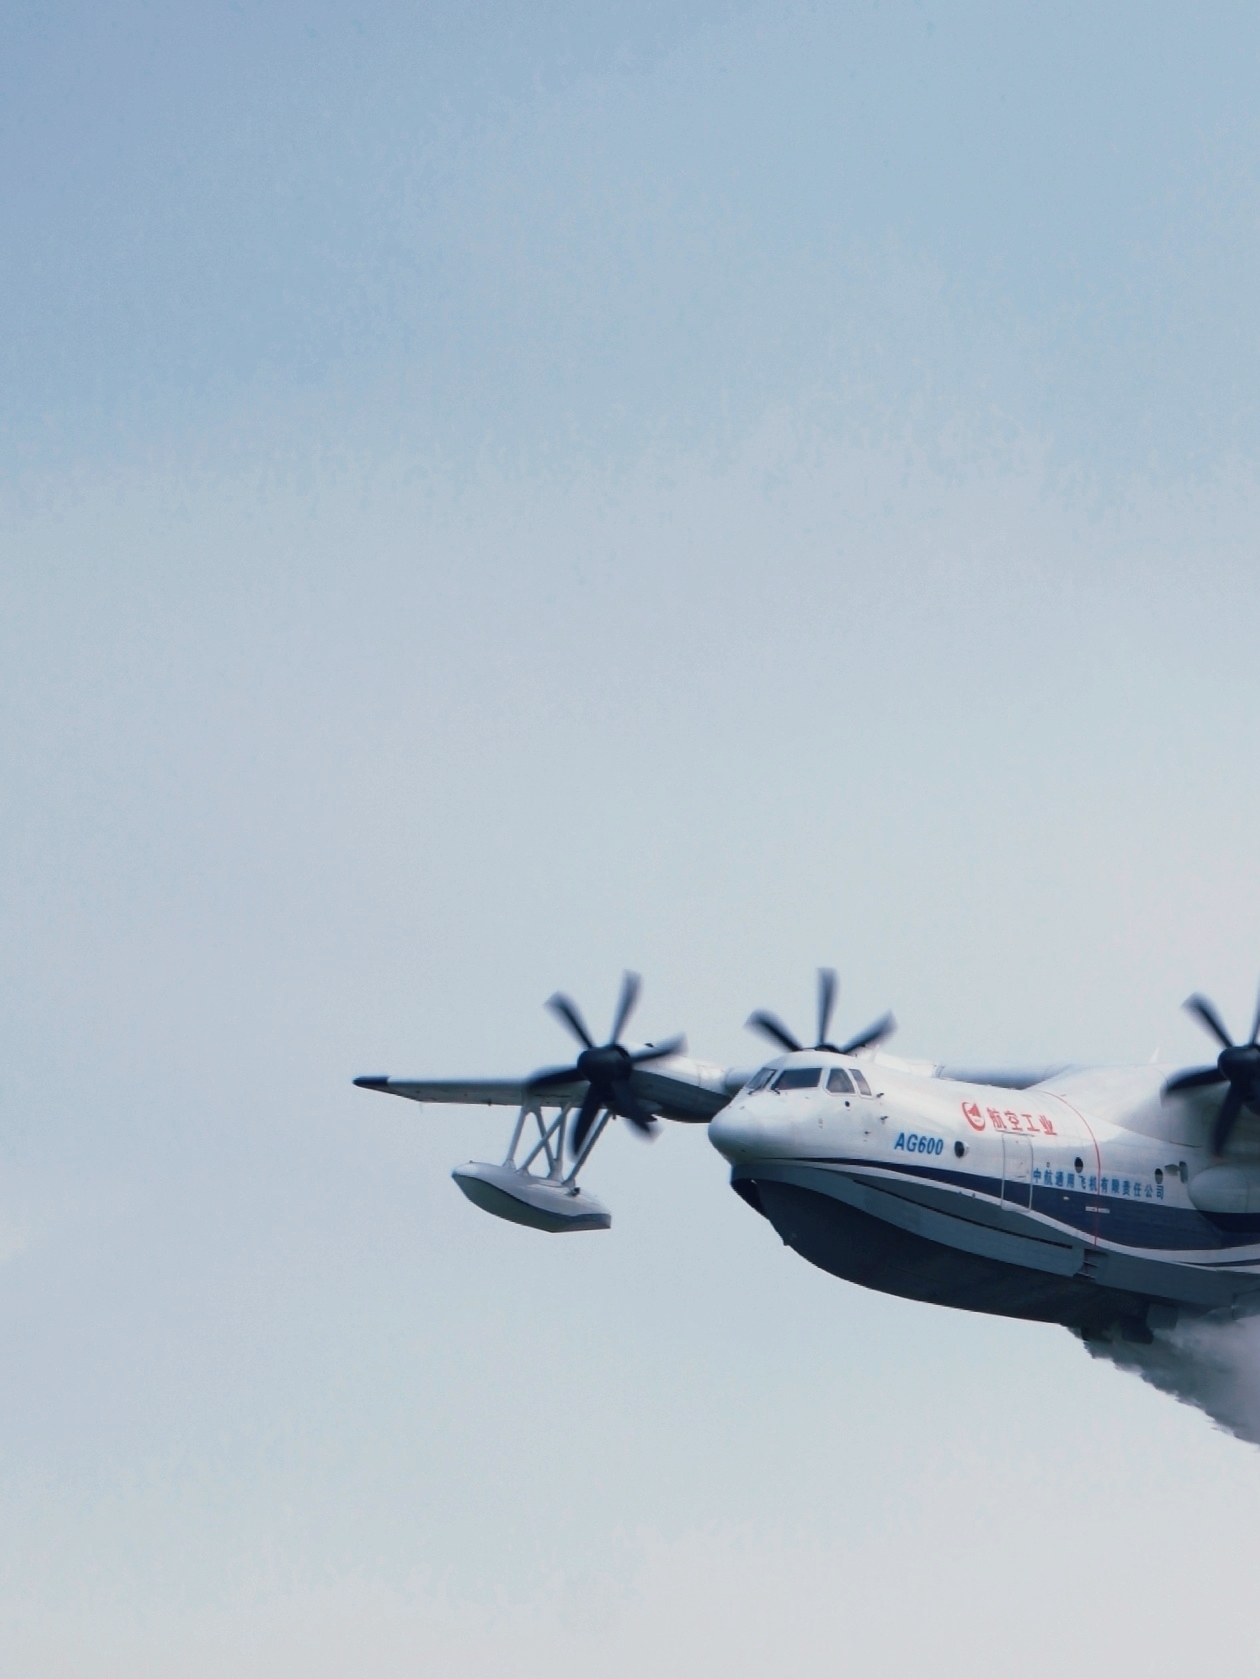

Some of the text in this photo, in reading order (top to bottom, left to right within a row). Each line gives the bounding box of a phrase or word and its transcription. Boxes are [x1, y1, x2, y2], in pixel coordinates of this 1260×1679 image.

[986, 1107, 1057, 1136] 航空工业
[894, 1132, 944, 1156] AG600
[1033, 1167, 1164, 1200] 中航通用飞机有限责任公司
